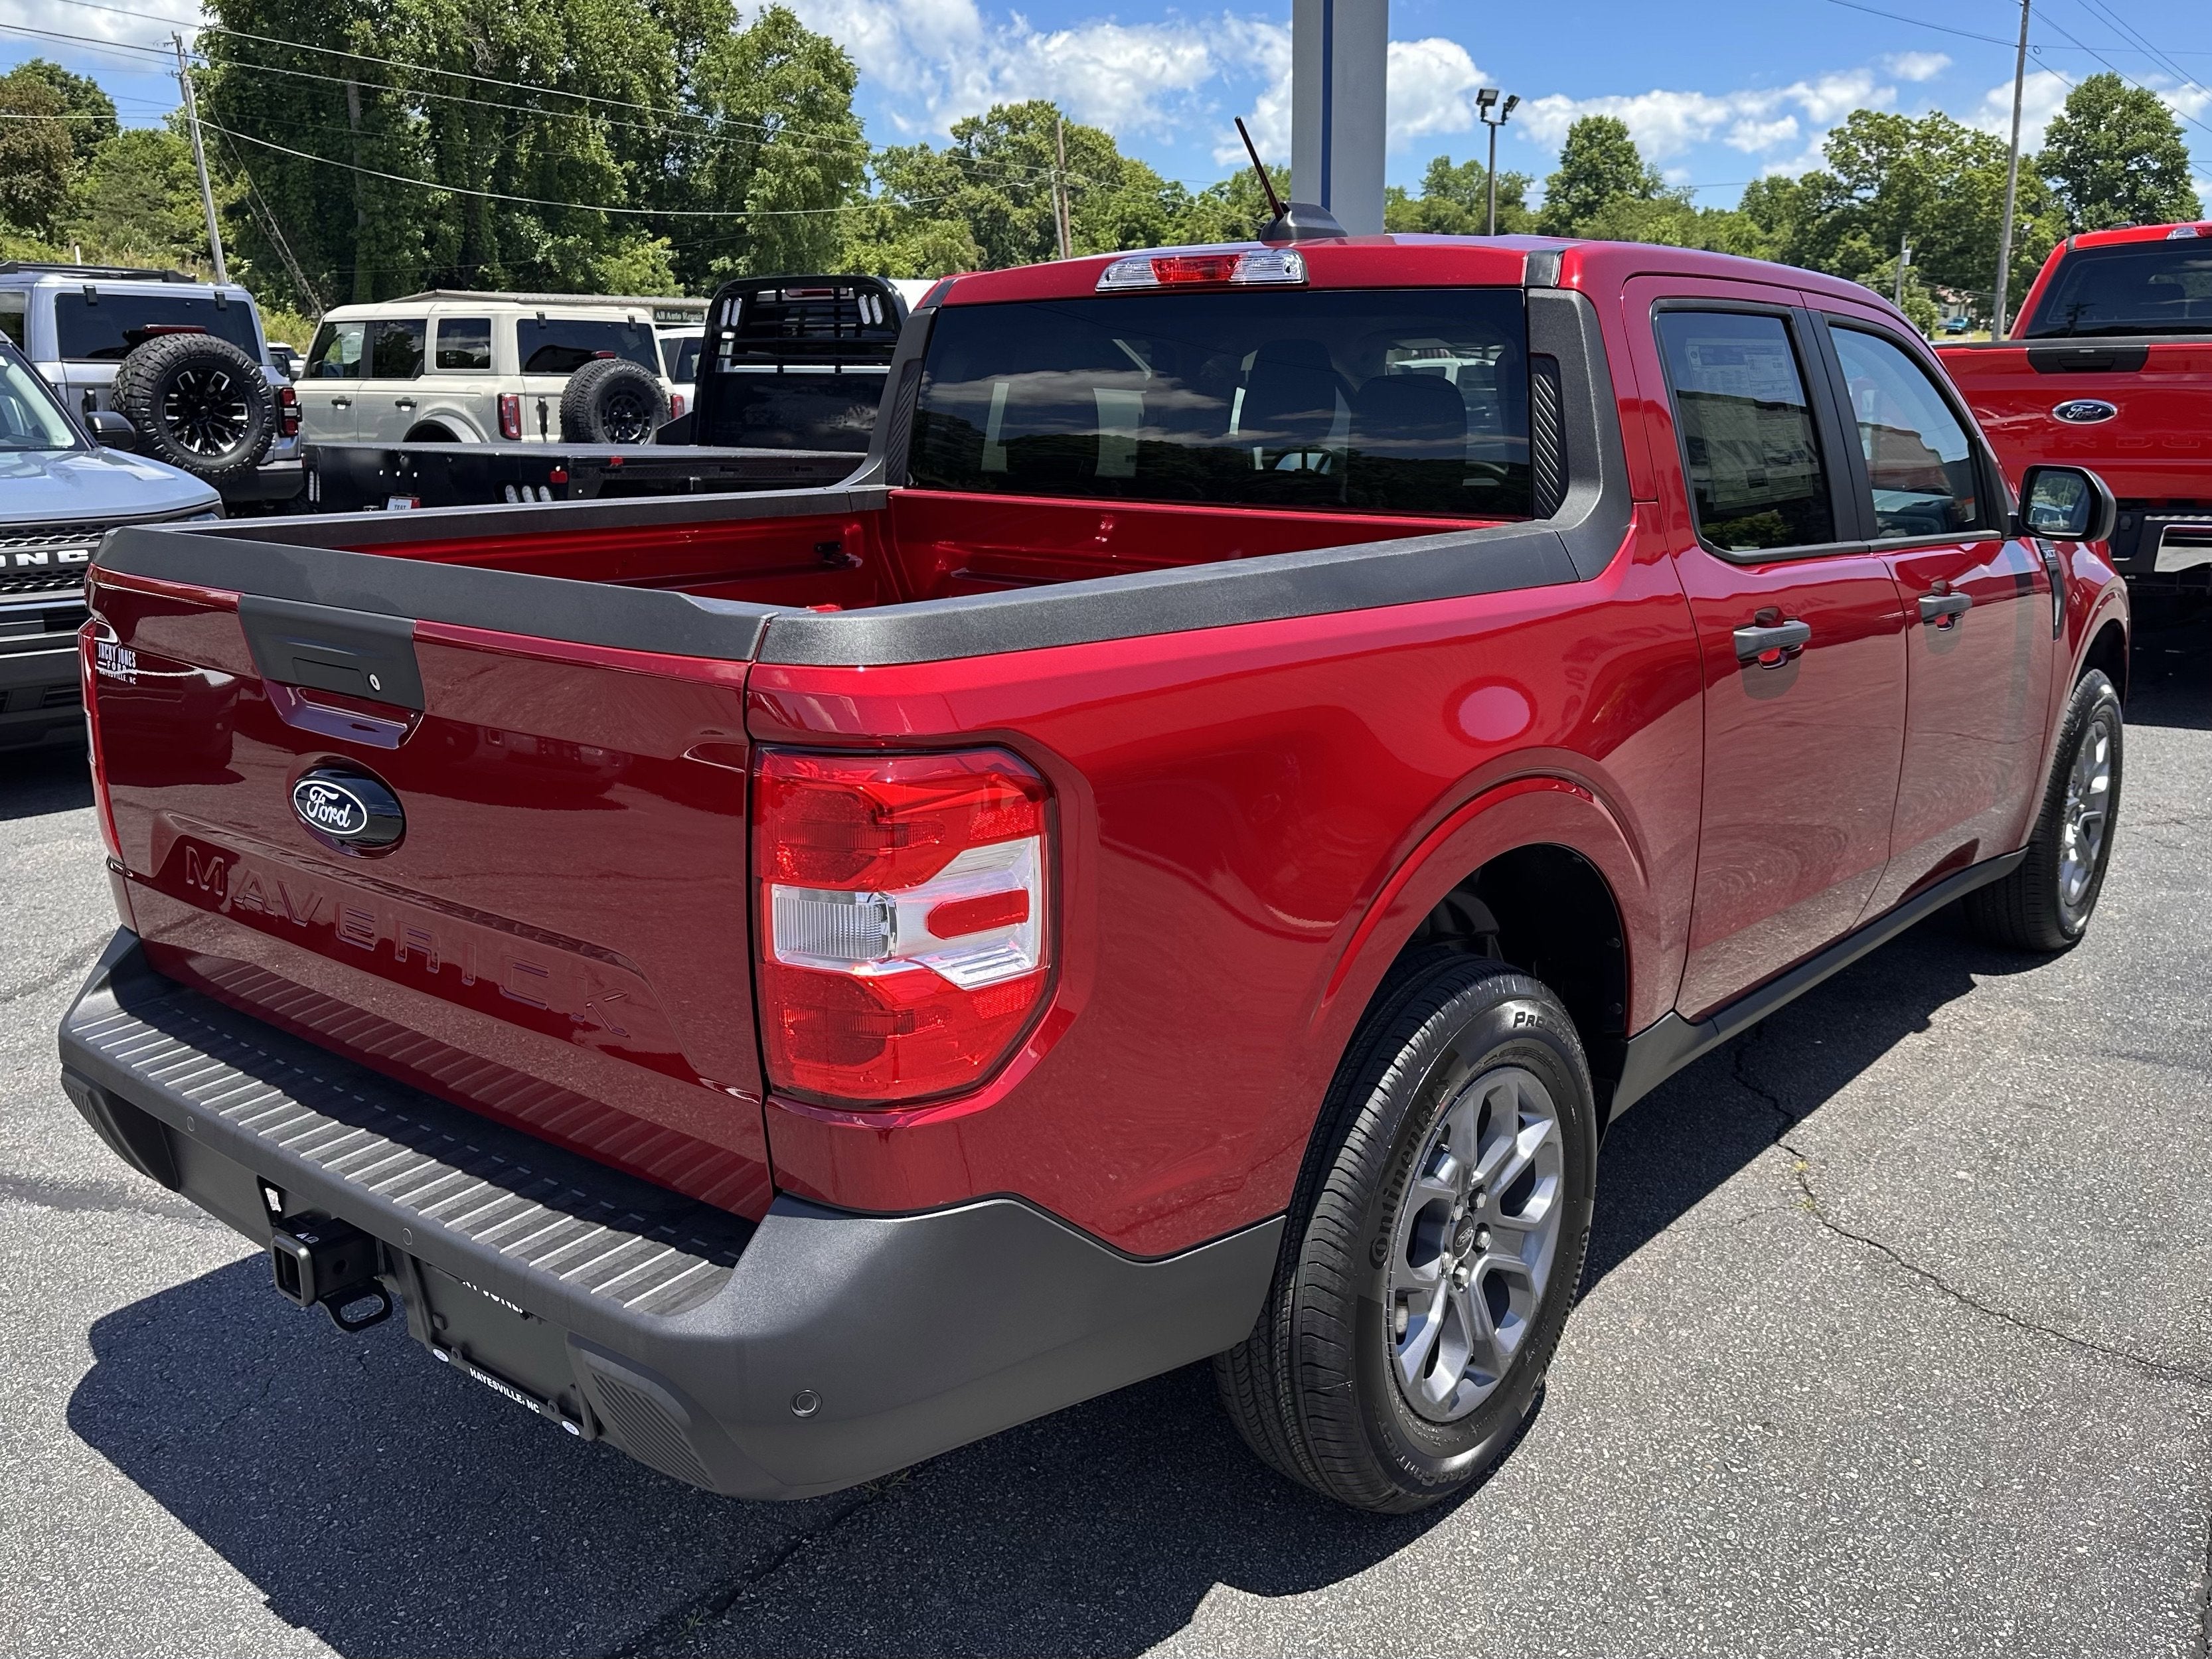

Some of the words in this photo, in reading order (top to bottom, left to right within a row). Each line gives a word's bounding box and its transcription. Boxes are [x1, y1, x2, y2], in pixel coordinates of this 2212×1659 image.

[656, 311, 665, 320] All
[666, 311, 682, 320] Auto
[2065, 404, 2102, 420] Ford
[0, 549, 89, 568] NC
[98, 642, 116, 662] JACKY
[118, 647, 136, 668] JONES
[129, 676, 136, 684] NC
[306, 786, 352, 828] Ford
[185, 845, 630, 1038] MAVERICK
[469, 1367, 526, 1405] HAYESVILLE,
[526, 1399, 540, 1414] NC
